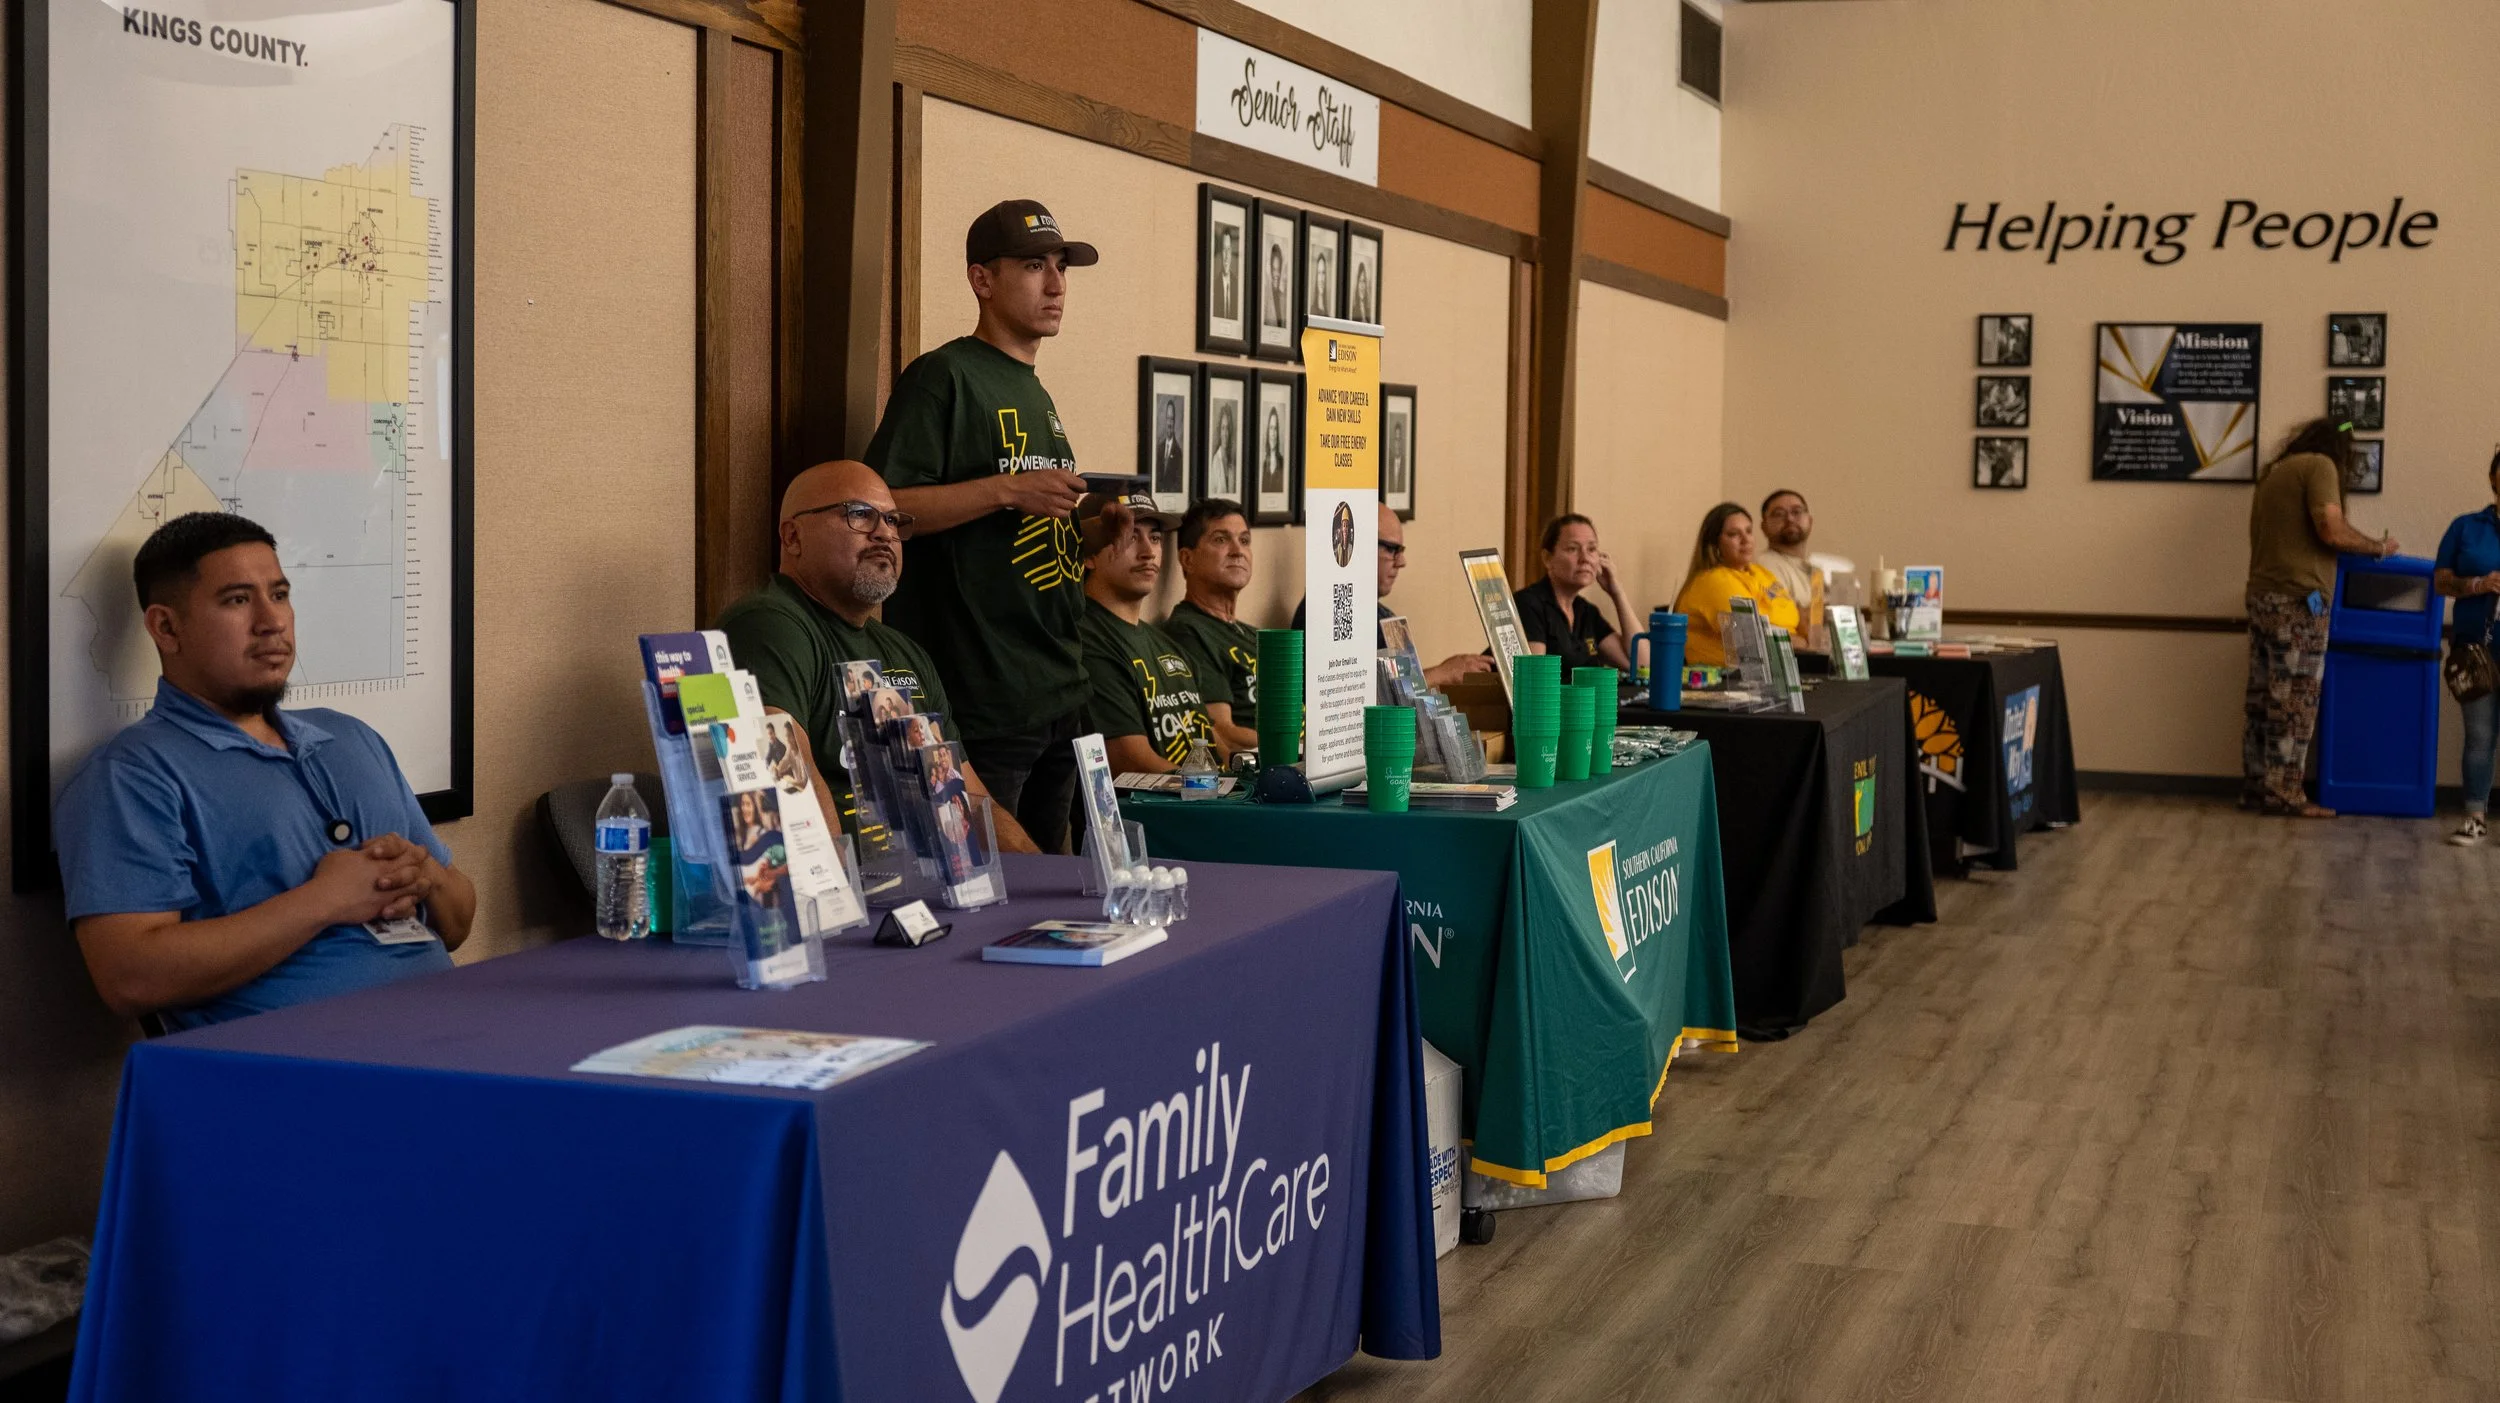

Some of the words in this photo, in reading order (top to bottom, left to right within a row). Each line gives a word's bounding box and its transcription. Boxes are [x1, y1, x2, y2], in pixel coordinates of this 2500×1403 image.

[122, 7, 202, 46] KINGS
[210, 25, 309, 67] COUNTY.
[1231, 57, 1300, 132] Senior
[1306, 85, 1355, 168] Staff
[1943, 200, 2196, 266] Helping
[2213, 196, 2439, 264] People
[2174, 331, 2250, 350] Mission
[1318, 388, 1337, 404] ADVANCE
[1338, 390, 1349, 405] YOUR
[1350, 391, 1365, 406] CAREER
[1326, 407, 1336, 422] GAIN
[1337, 408, 1347, 423] NEW
[1347, 409, 1361, 423] SKILLS
[2116, 407, 2174, 425] Vision
[1320, 433, 1331, 448] TAKE
[1331, 434, 1340, 448] OUR
[1340, 435, 1350, 449] FREE
[1351, 435, 1367, 450] ENERGY
[998, 455, 1057, 473] POWERING
[1334, 453, 1352, 467] CLASSES
[654, 650, 670, 664] this
[669, 652, 684, 665] way
[683, 650, 692, 662] to
[1622, 849, 1650, 880] SOUTHERN
[1650, 836, 1679, 866] CALIFORNIA
[1626, 864, 1679, 946] EDISON
[1064, 1041, 1251, 1238] Family
[1430, 1154, 1441, 1169] ADE
[1430, 1160, 1456, 1188] ESPECT
[1055, 1153, 1329, 1386] HealthCare
[1085, 1312, 1225, 1403] TWORK
